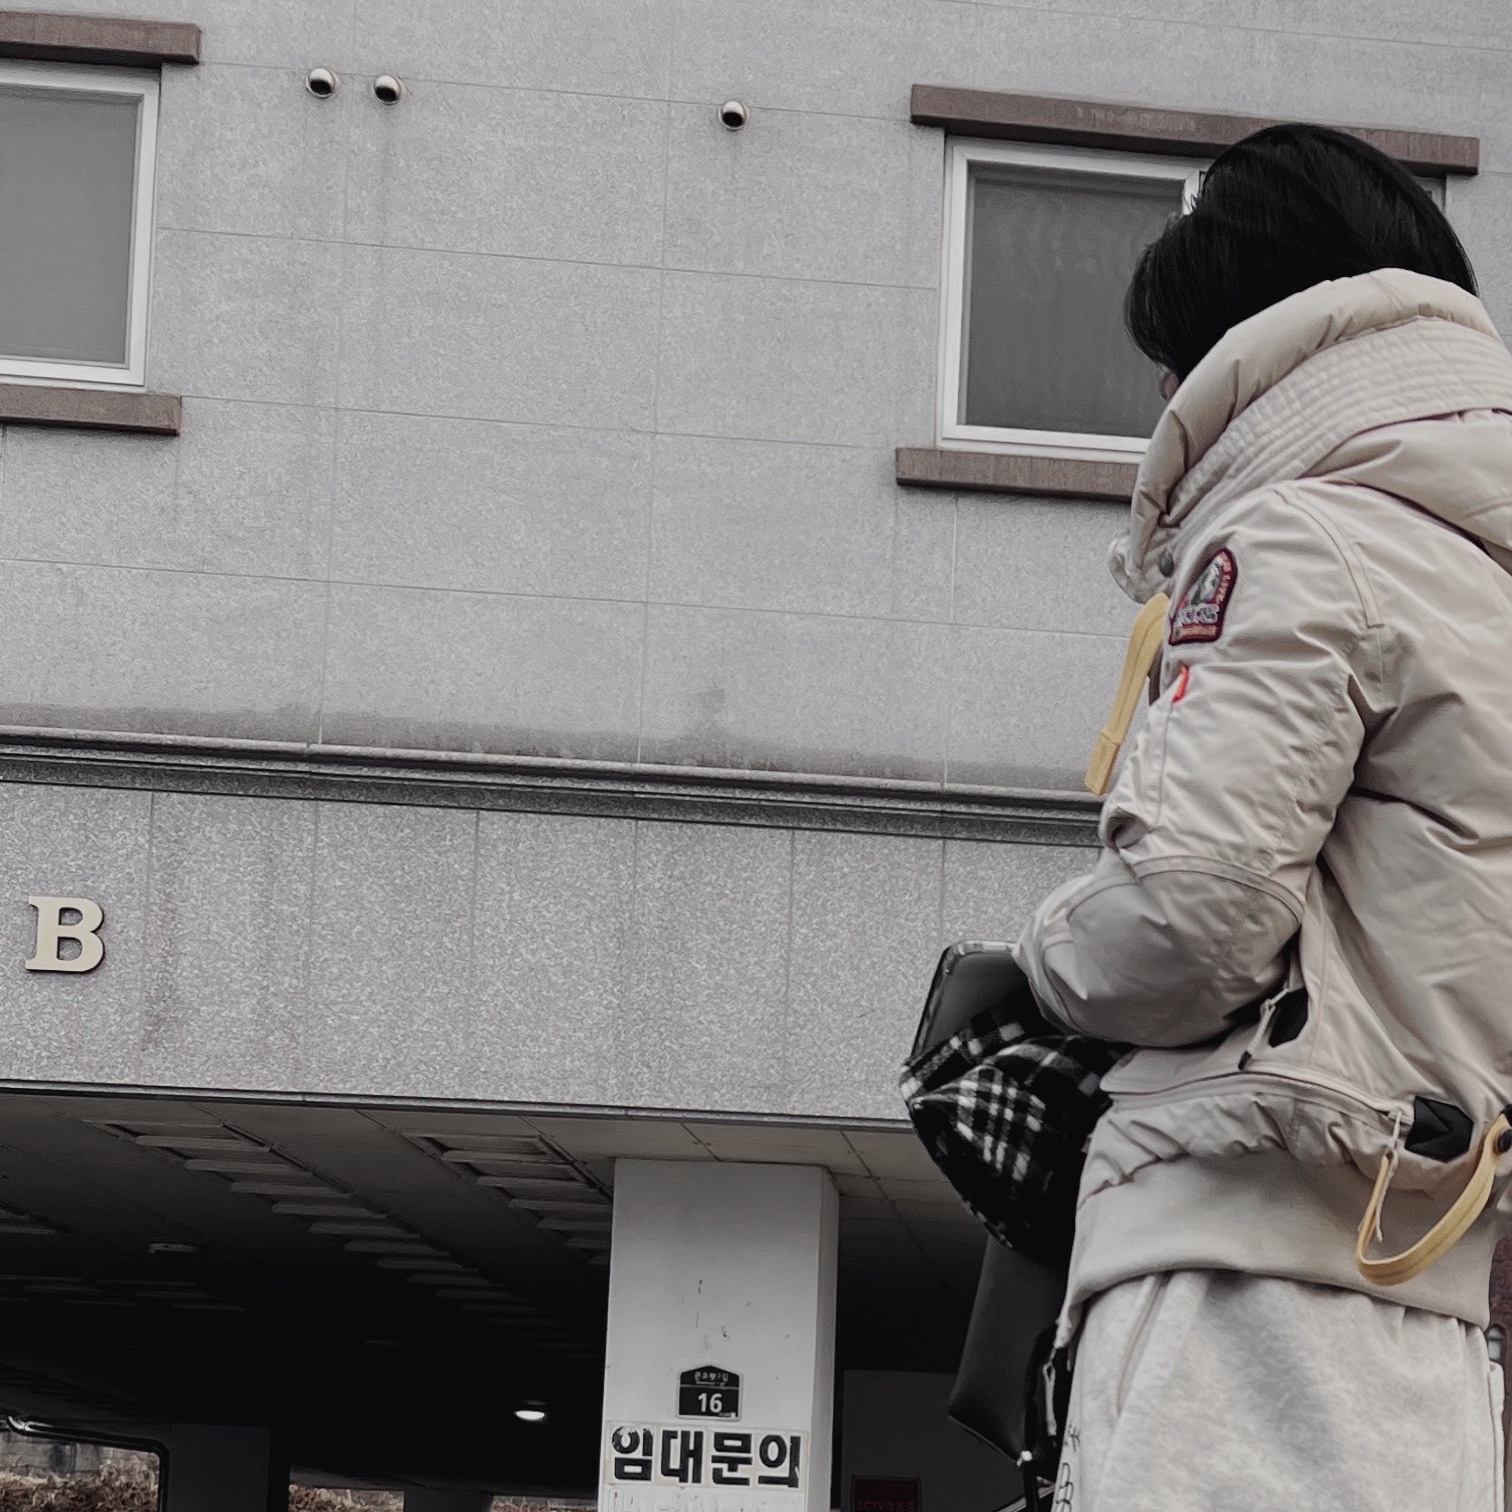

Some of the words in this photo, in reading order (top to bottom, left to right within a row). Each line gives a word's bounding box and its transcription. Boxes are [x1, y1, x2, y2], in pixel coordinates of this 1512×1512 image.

[25, 895, 104, 973] B
[698, 1392, 722, 1413] 16
[611, 1425, 801, 1488] 임대문의
